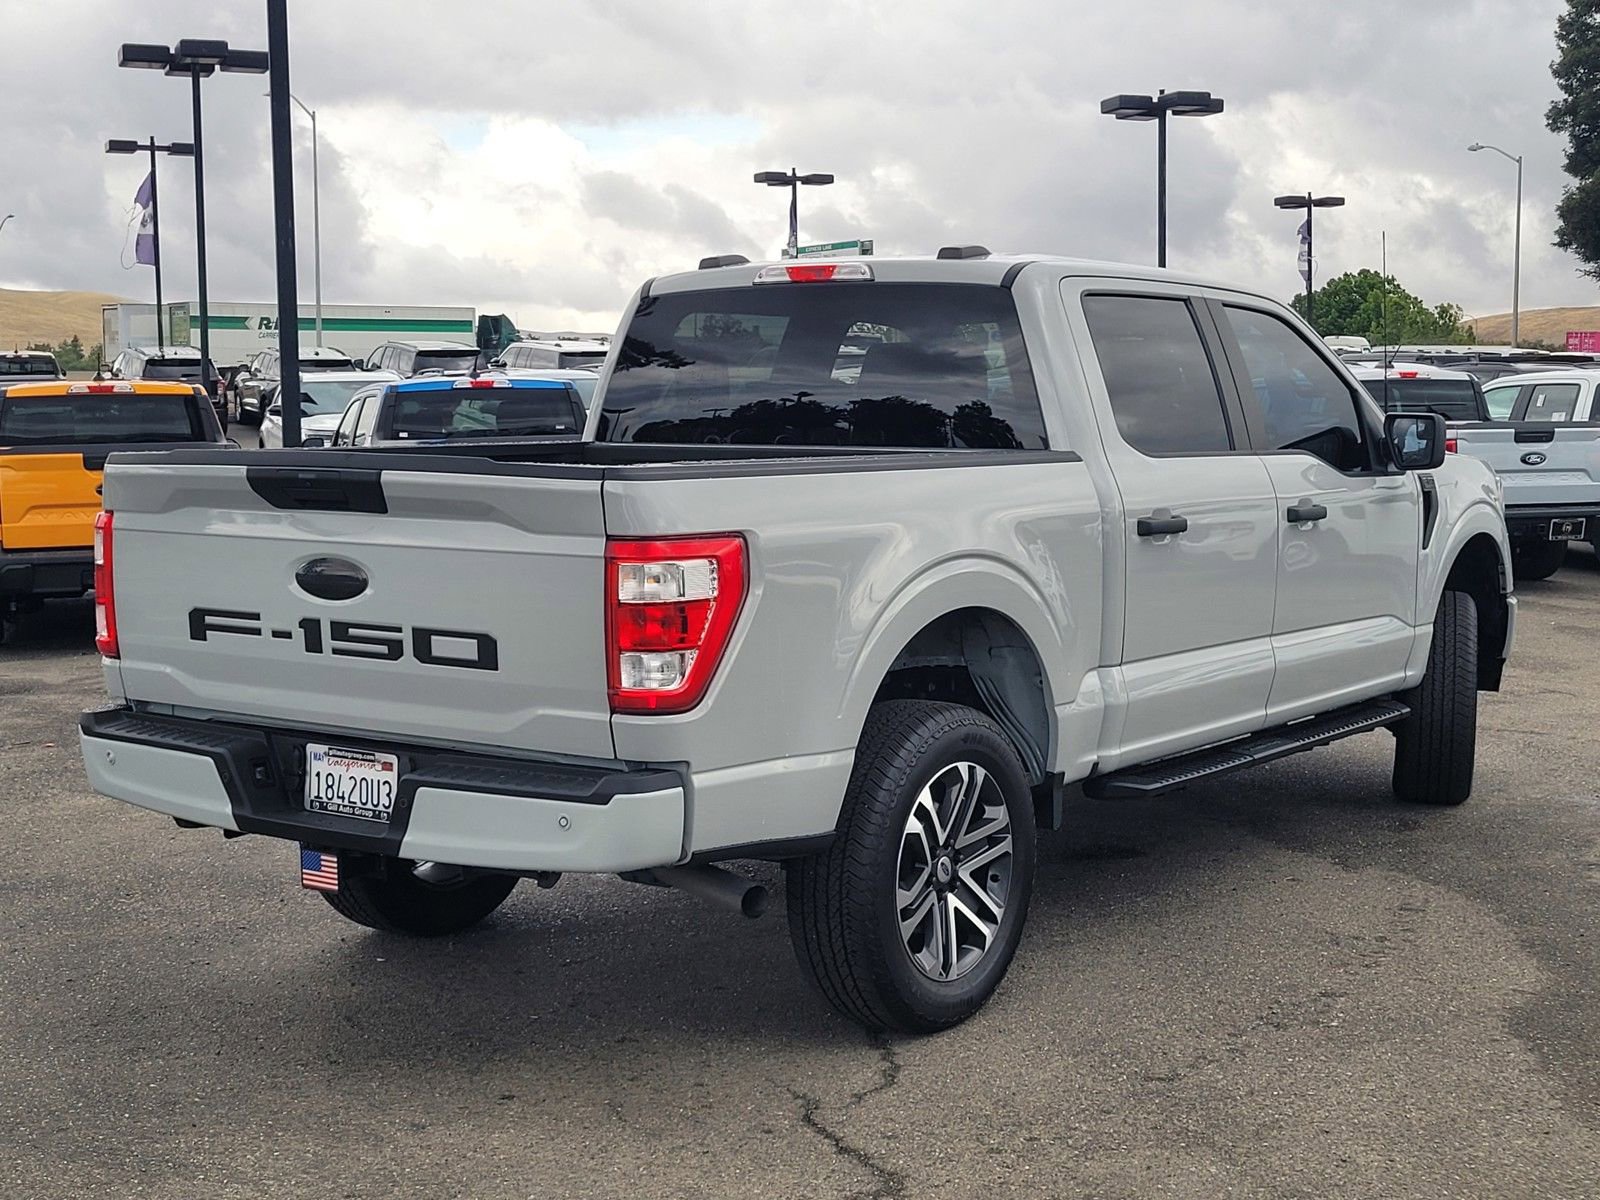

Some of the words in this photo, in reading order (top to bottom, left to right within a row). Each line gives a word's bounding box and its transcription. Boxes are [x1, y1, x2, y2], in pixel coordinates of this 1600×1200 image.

[258, 331, 279, 339] CARRIE
[188, 607, 499, 672] F-150
[327, 757, 377, 773] California
[327, 803, 338, 811] Gill
[338, 805, 353, 814] Auto
[354, 808, 373, 818] Group
